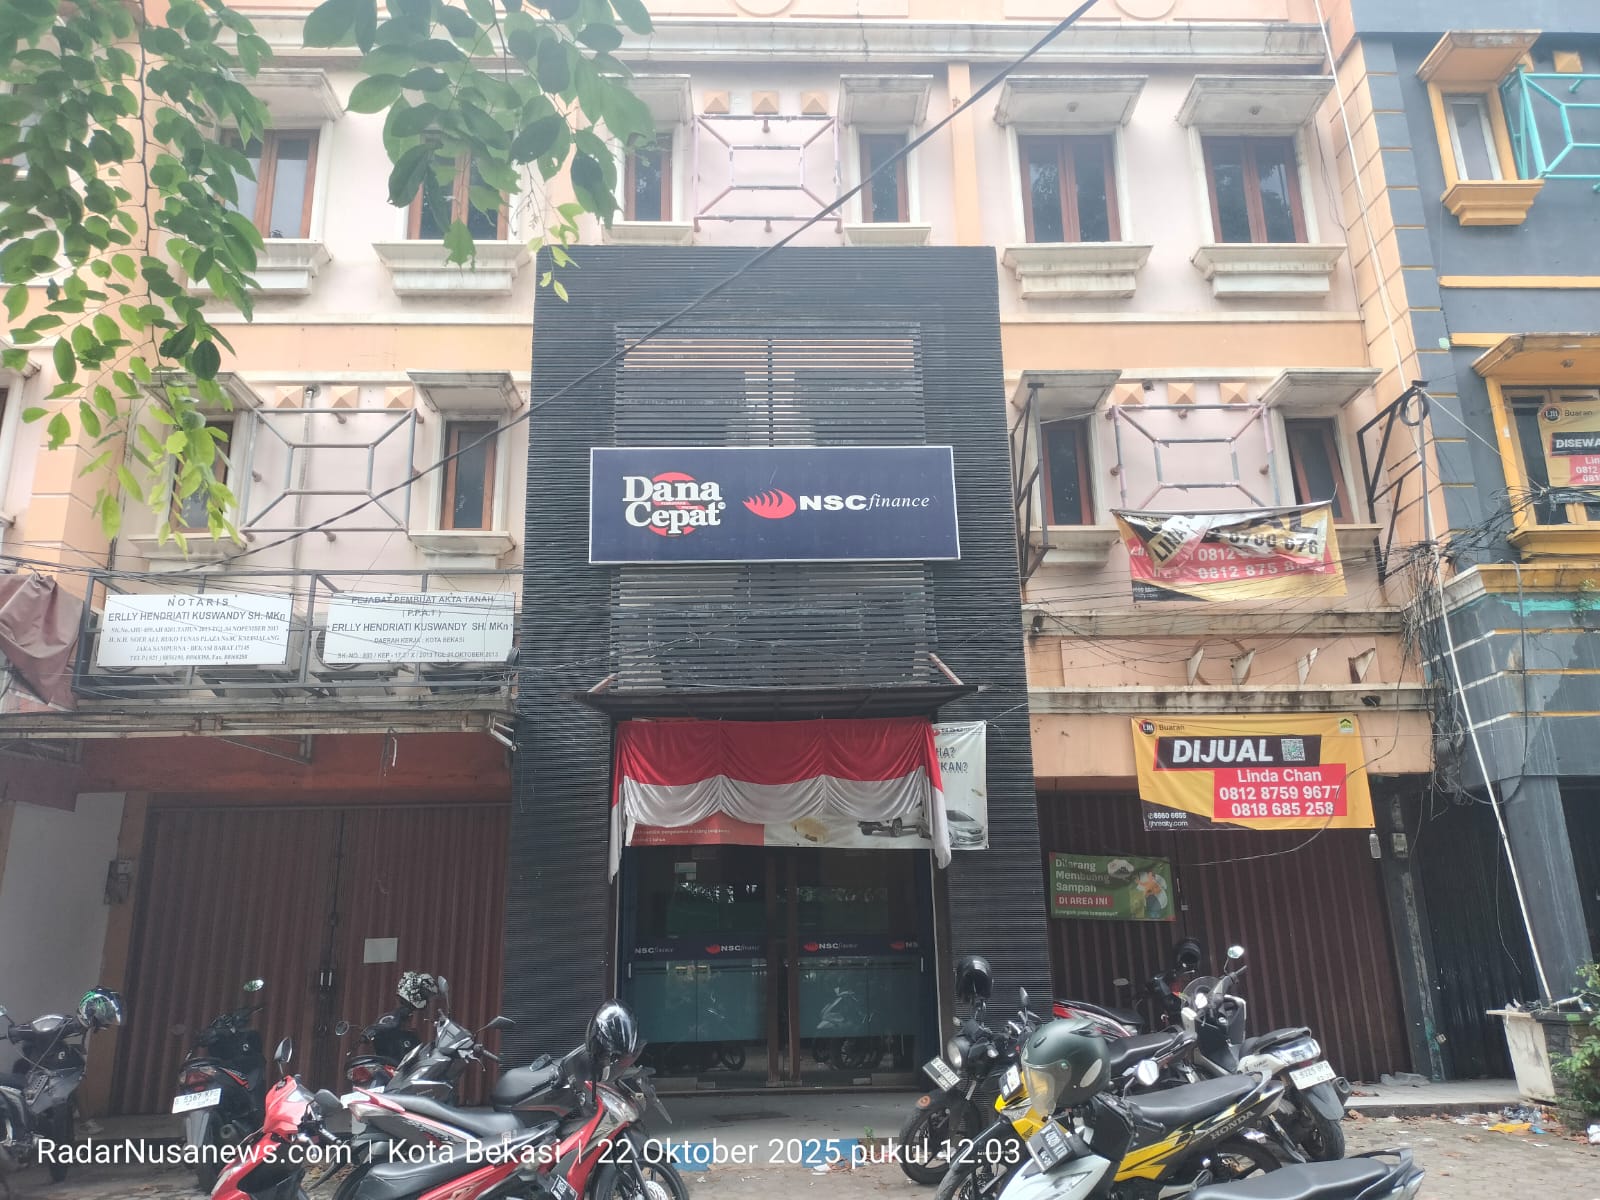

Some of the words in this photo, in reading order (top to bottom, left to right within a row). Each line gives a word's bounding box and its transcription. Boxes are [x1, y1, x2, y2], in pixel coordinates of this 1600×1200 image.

[622, 476, 723, 503] Dana
[799, 494, 867, 510] NSC
[866, 494, 930, 511] finance
[624, 501, 722, 534] Cepat
[1198, 547, 1236, 561] 0812
[1198, 566, 1240, 579] 0812
[1245, 562, 1278, 576] 875
[108, 612, 138, 622] ERLLY
[140, 611, 190, 621] HENDRIATI
[192, 611, 246, 620] KUSWANDY
[332, 623, 362, 632] ERLLY
[363, 623, 412, 632] HENDRIATI
[414, 622, 467, 632] KUSWANDY
[489, 622, 509, 631] MKn
[1172, 739, 1273, 763] DIJUAL
[1237, 770, 1279, 783] Linda
[1283, 769, 1322, 782] Chan
[1219, 787, 1257, 801] 0812
[1261, 786, 1298, 800] 8759
[1302, 785, 1341, 799] 9677
[1231, 803, 1268, 816] 0818
[1271, 803, 1301, 816] 685
[1305, 801, 1334, 815] 258
[1056, 883, 1097, 894] Sampah
[1059, 896, 1068, 905] DI
[1070, 896, 1094, 905] AREA
[1096, 896, 1108, 905] INI
[1210, 1110, 1256, 1141] HONDA
